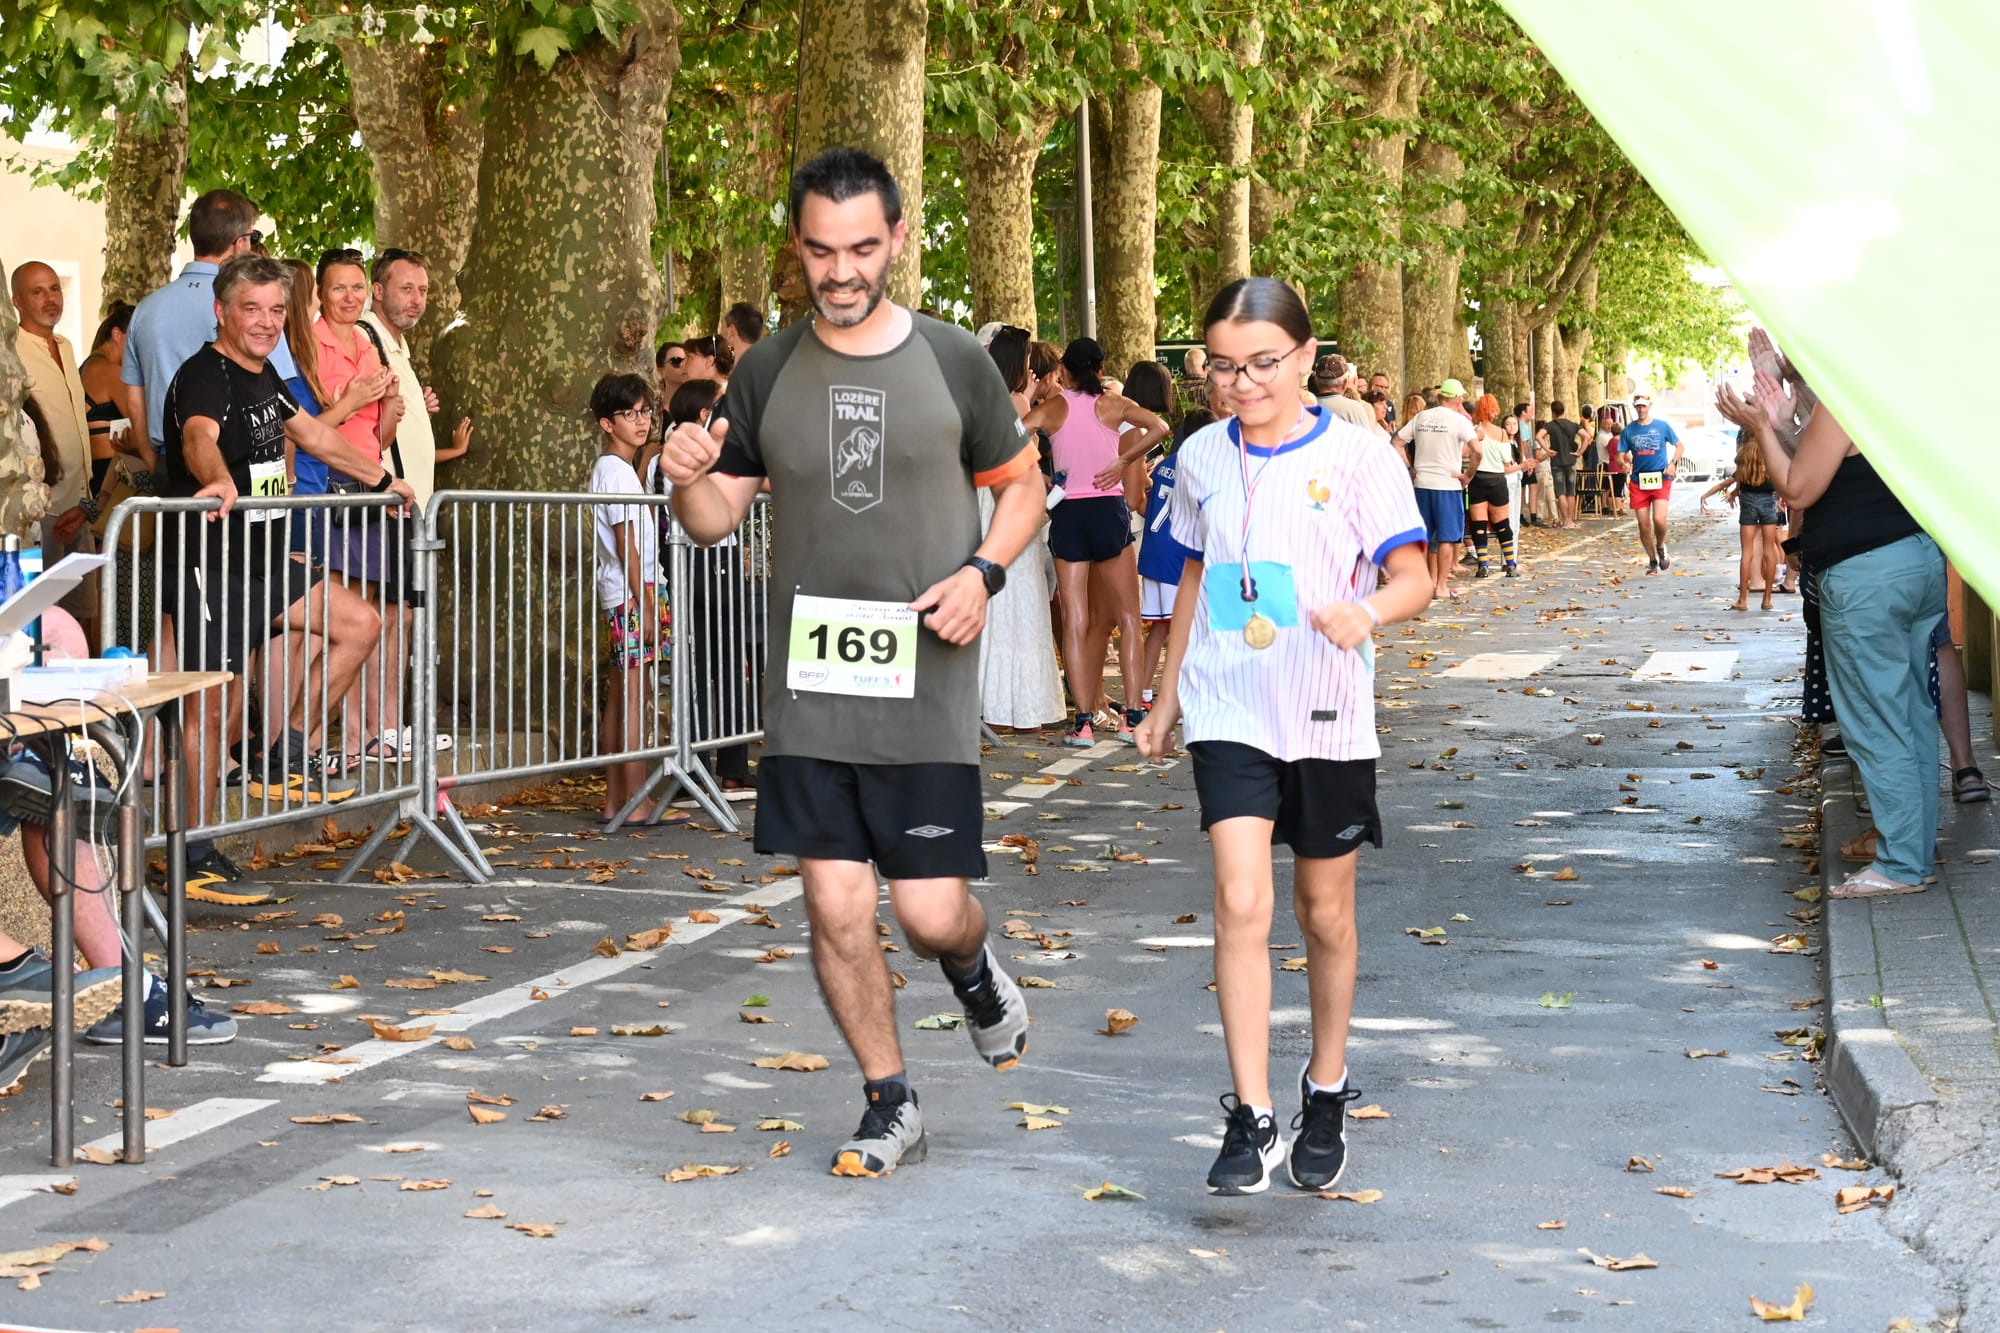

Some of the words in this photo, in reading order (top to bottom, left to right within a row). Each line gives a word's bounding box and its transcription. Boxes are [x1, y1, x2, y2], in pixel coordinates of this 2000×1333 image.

[835, 391, 880, 406] LOZÈRE
[836, 404, 880, 422] TRAIL
[260, 478, 286, 497] 104
[1642, 477, 1658, 485] 141
[1150, 484, 1173, 532] 7
[808, 624, 898, 665] 169
[799, 670, 825, 679] BFP
